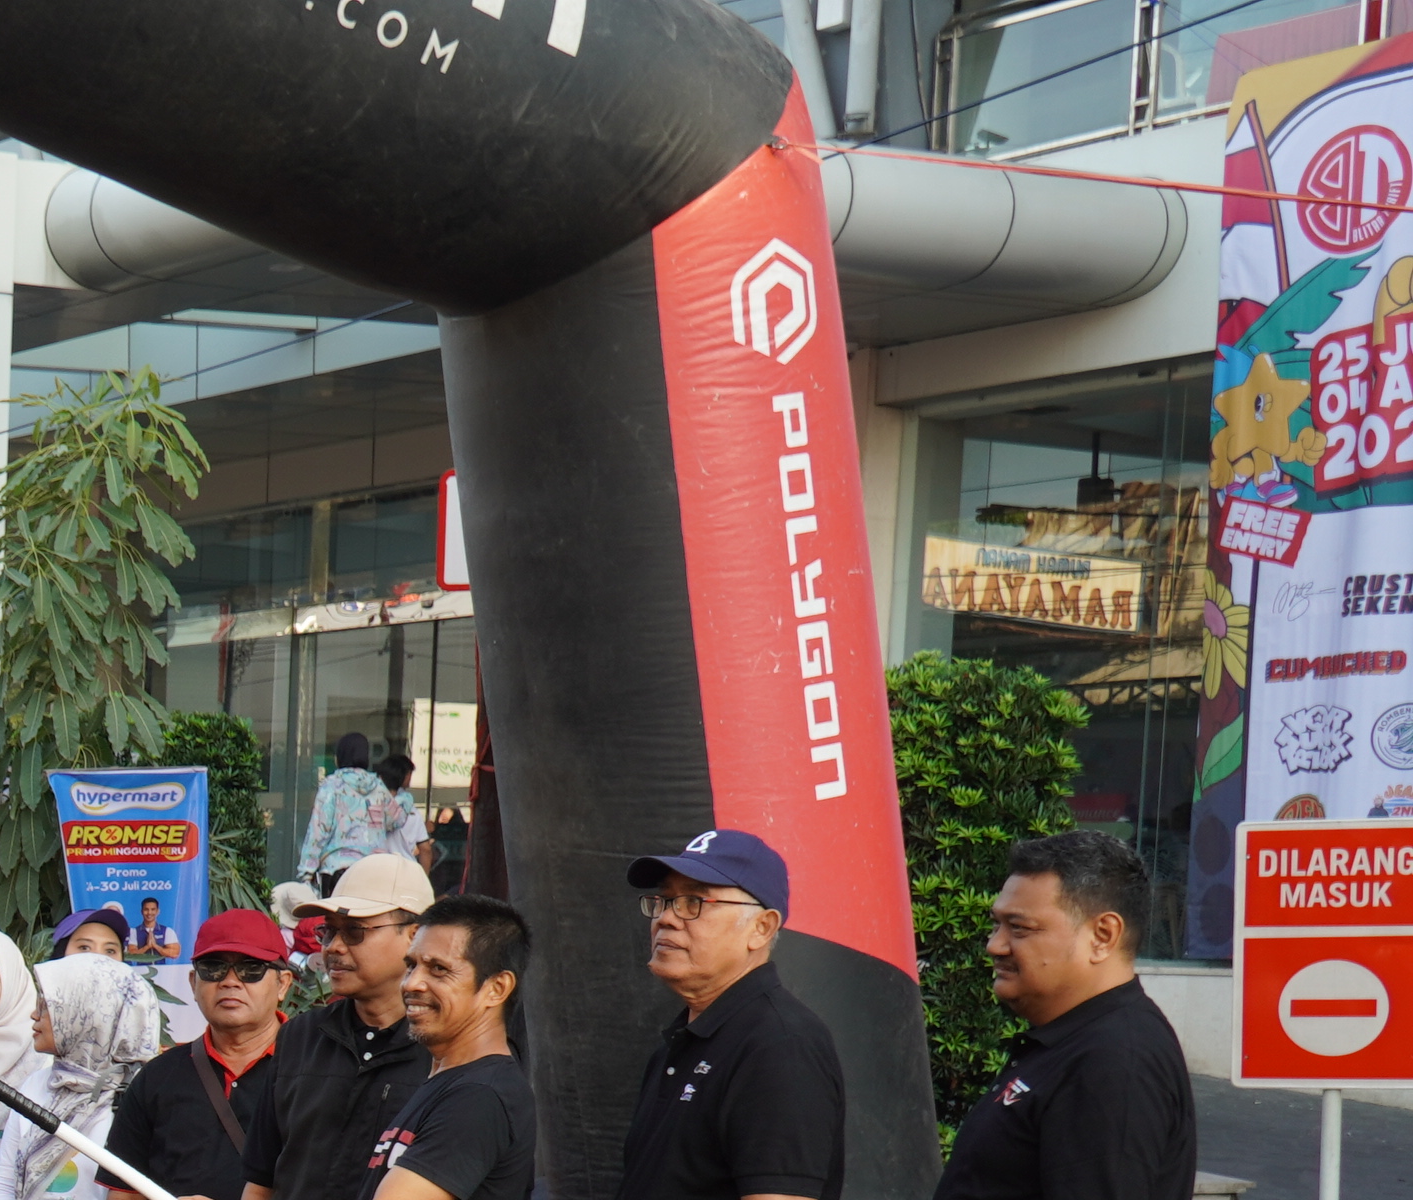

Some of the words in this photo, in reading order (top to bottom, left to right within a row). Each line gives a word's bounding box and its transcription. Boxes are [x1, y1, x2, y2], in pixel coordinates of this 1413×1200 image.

[1318, 334, 1369, 384] 25
[1319, 377, 1367, 424] 04
[1226, 502, 1300, 540] FREE
[1220, 527, 1291, 560] ENTRY
[773, 391, 847, 801] POLYGON
[76, 789, 178, 805] hypermart
[68, 825, 187, 845] PROMISE
[103, 847, 160, 856] MINGGUAN
[161, 847, 187, 856] SERU
[1258, 847, 1413, 878] DILARANG
[106, 867, 147, 878] Promo
[122, 881, 140, 890] Juli
[141, 880, 172, 890] 2026
[1279, 882, 1392, 908] MASUK
